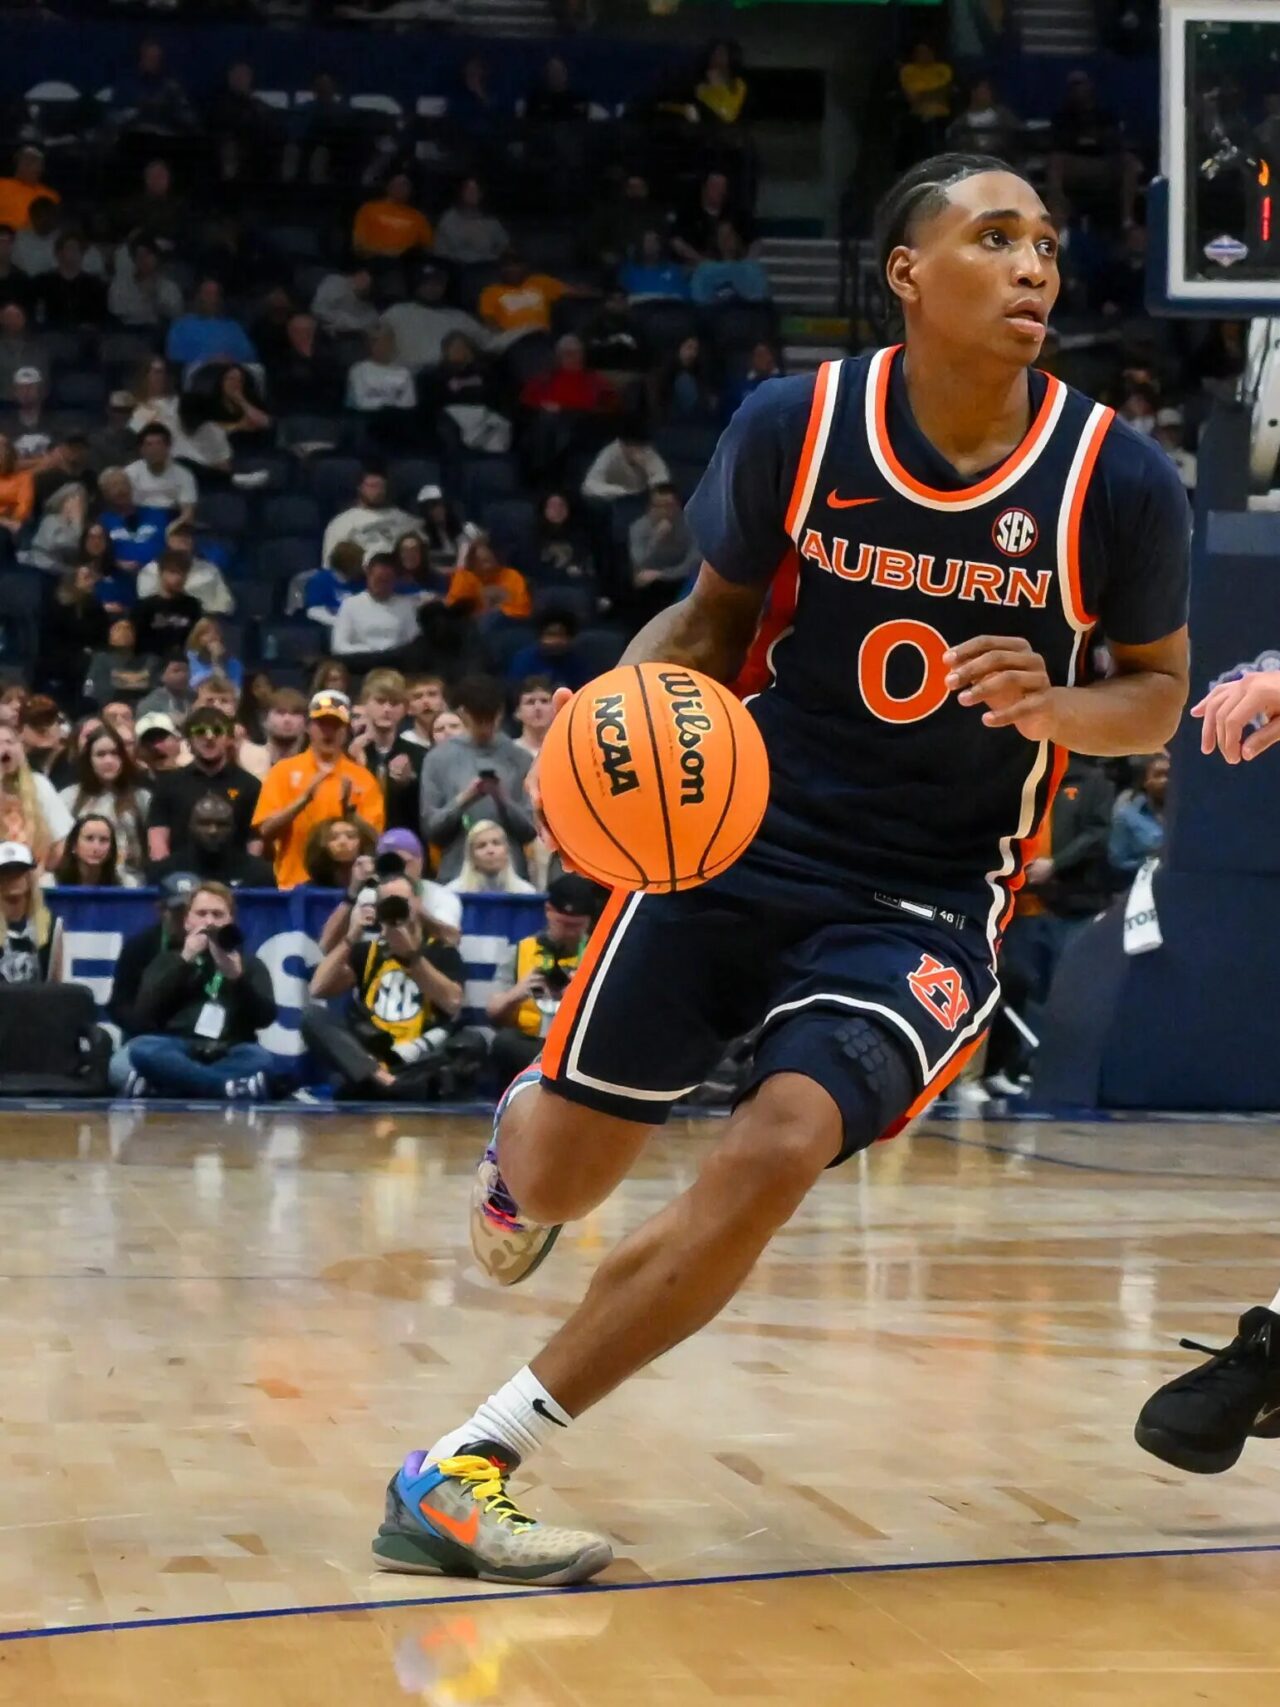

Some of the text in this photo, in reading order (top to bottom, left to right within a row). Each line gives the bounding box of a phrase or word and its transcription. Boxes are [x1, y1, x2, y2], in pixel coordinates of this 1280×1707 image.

[800, 528, 1052, 609] AUBURN
[996, 510, 1035, 553] SEC
[858, 618, 953, 724] 0
[593, 693, 641, 797] NCAA
[657, 671, 713, 807] Wilson
